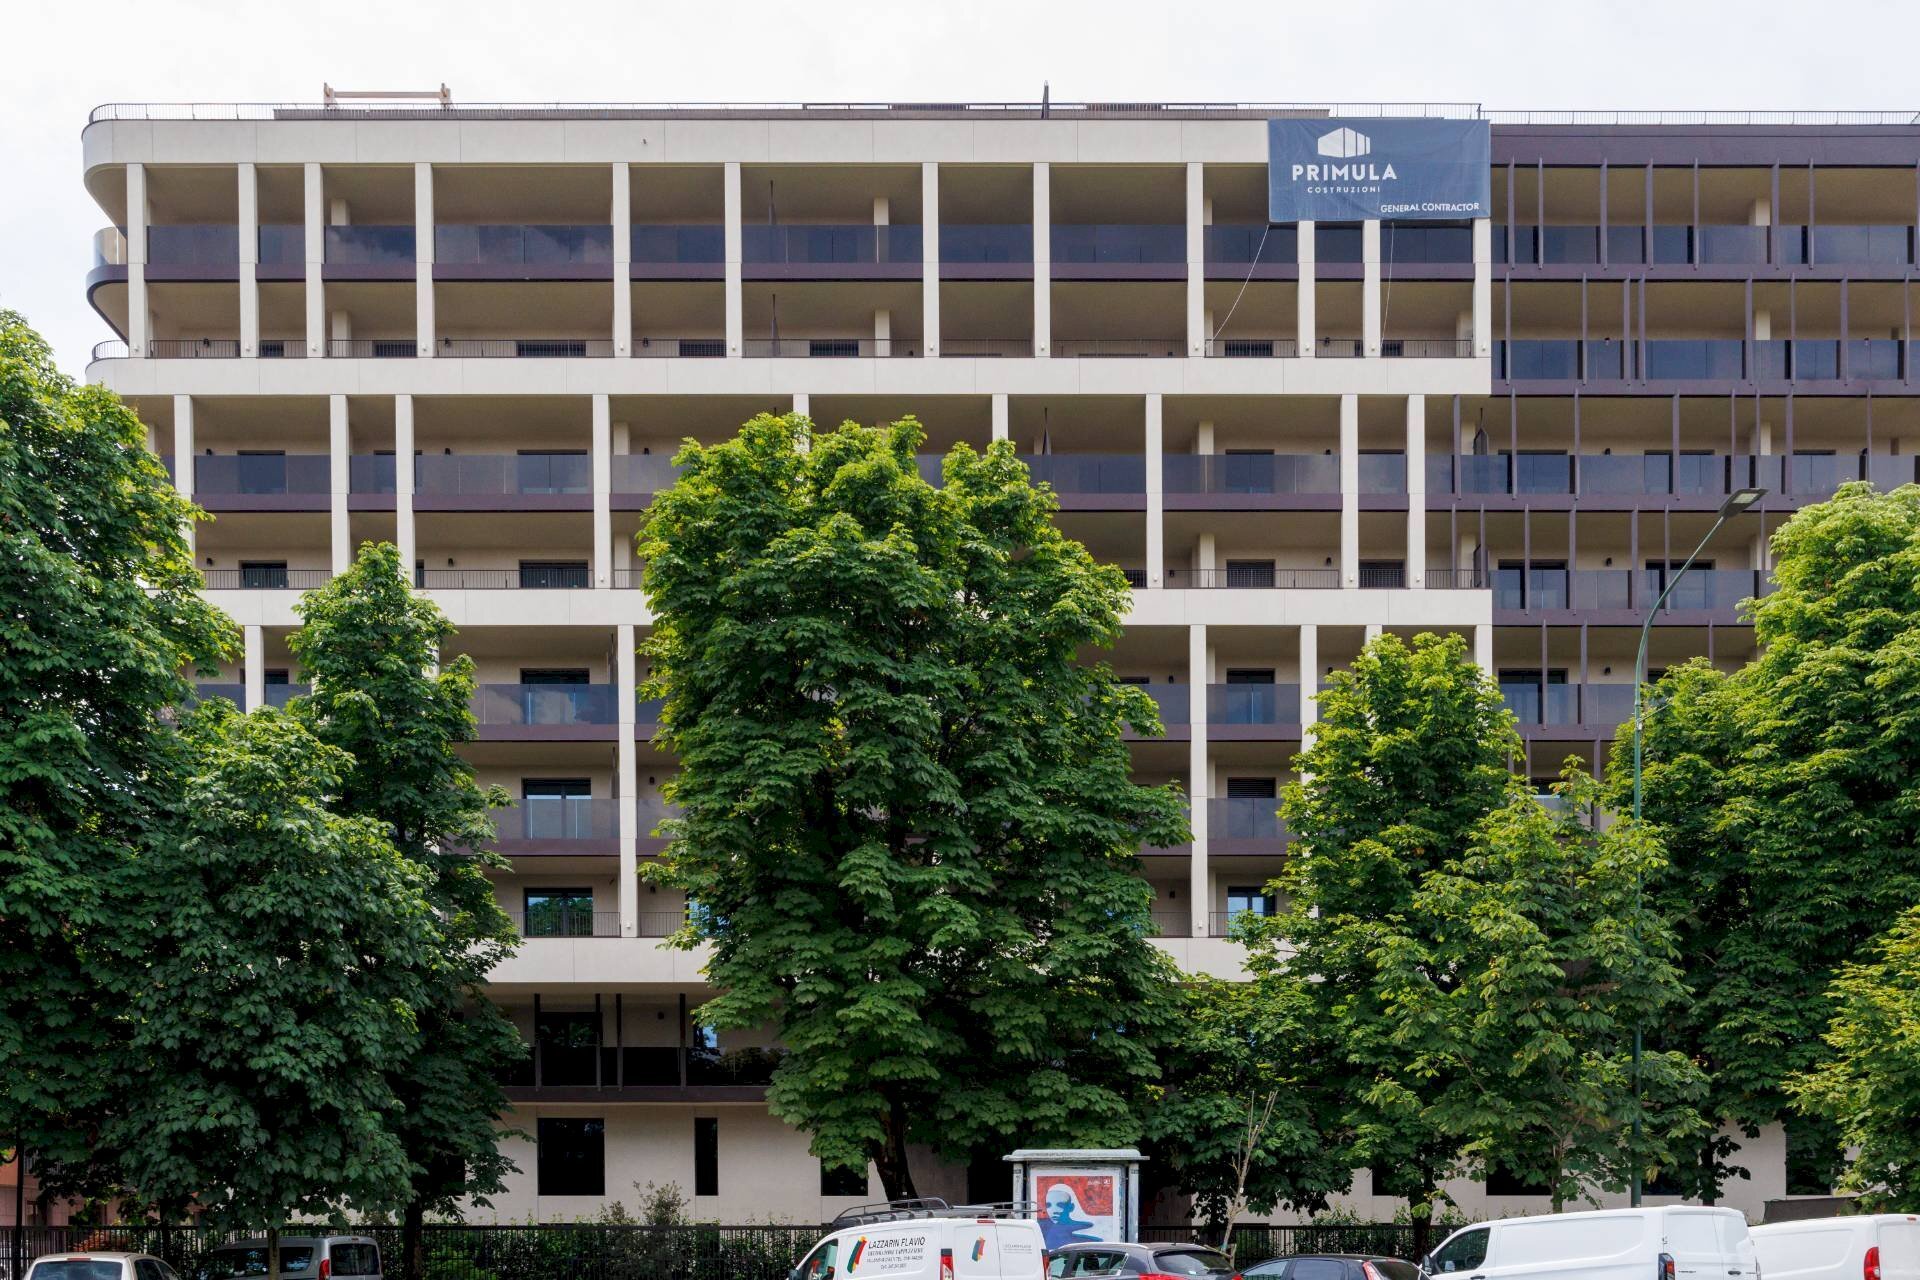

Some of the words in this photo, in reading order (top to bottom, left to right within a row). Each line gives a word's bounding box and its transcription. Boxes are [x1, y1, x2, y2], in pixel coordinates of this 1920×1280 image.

[1292, 163, 1398, 181] PRIMULA
[1380, 203, 1420, 213] GENERAL
[1421, 202, 1480, 212] CONTRACTOR
[868, 1239, 900, 1249] LAZZARIN
[901, 1236, 926, 1247] FLAVIO
